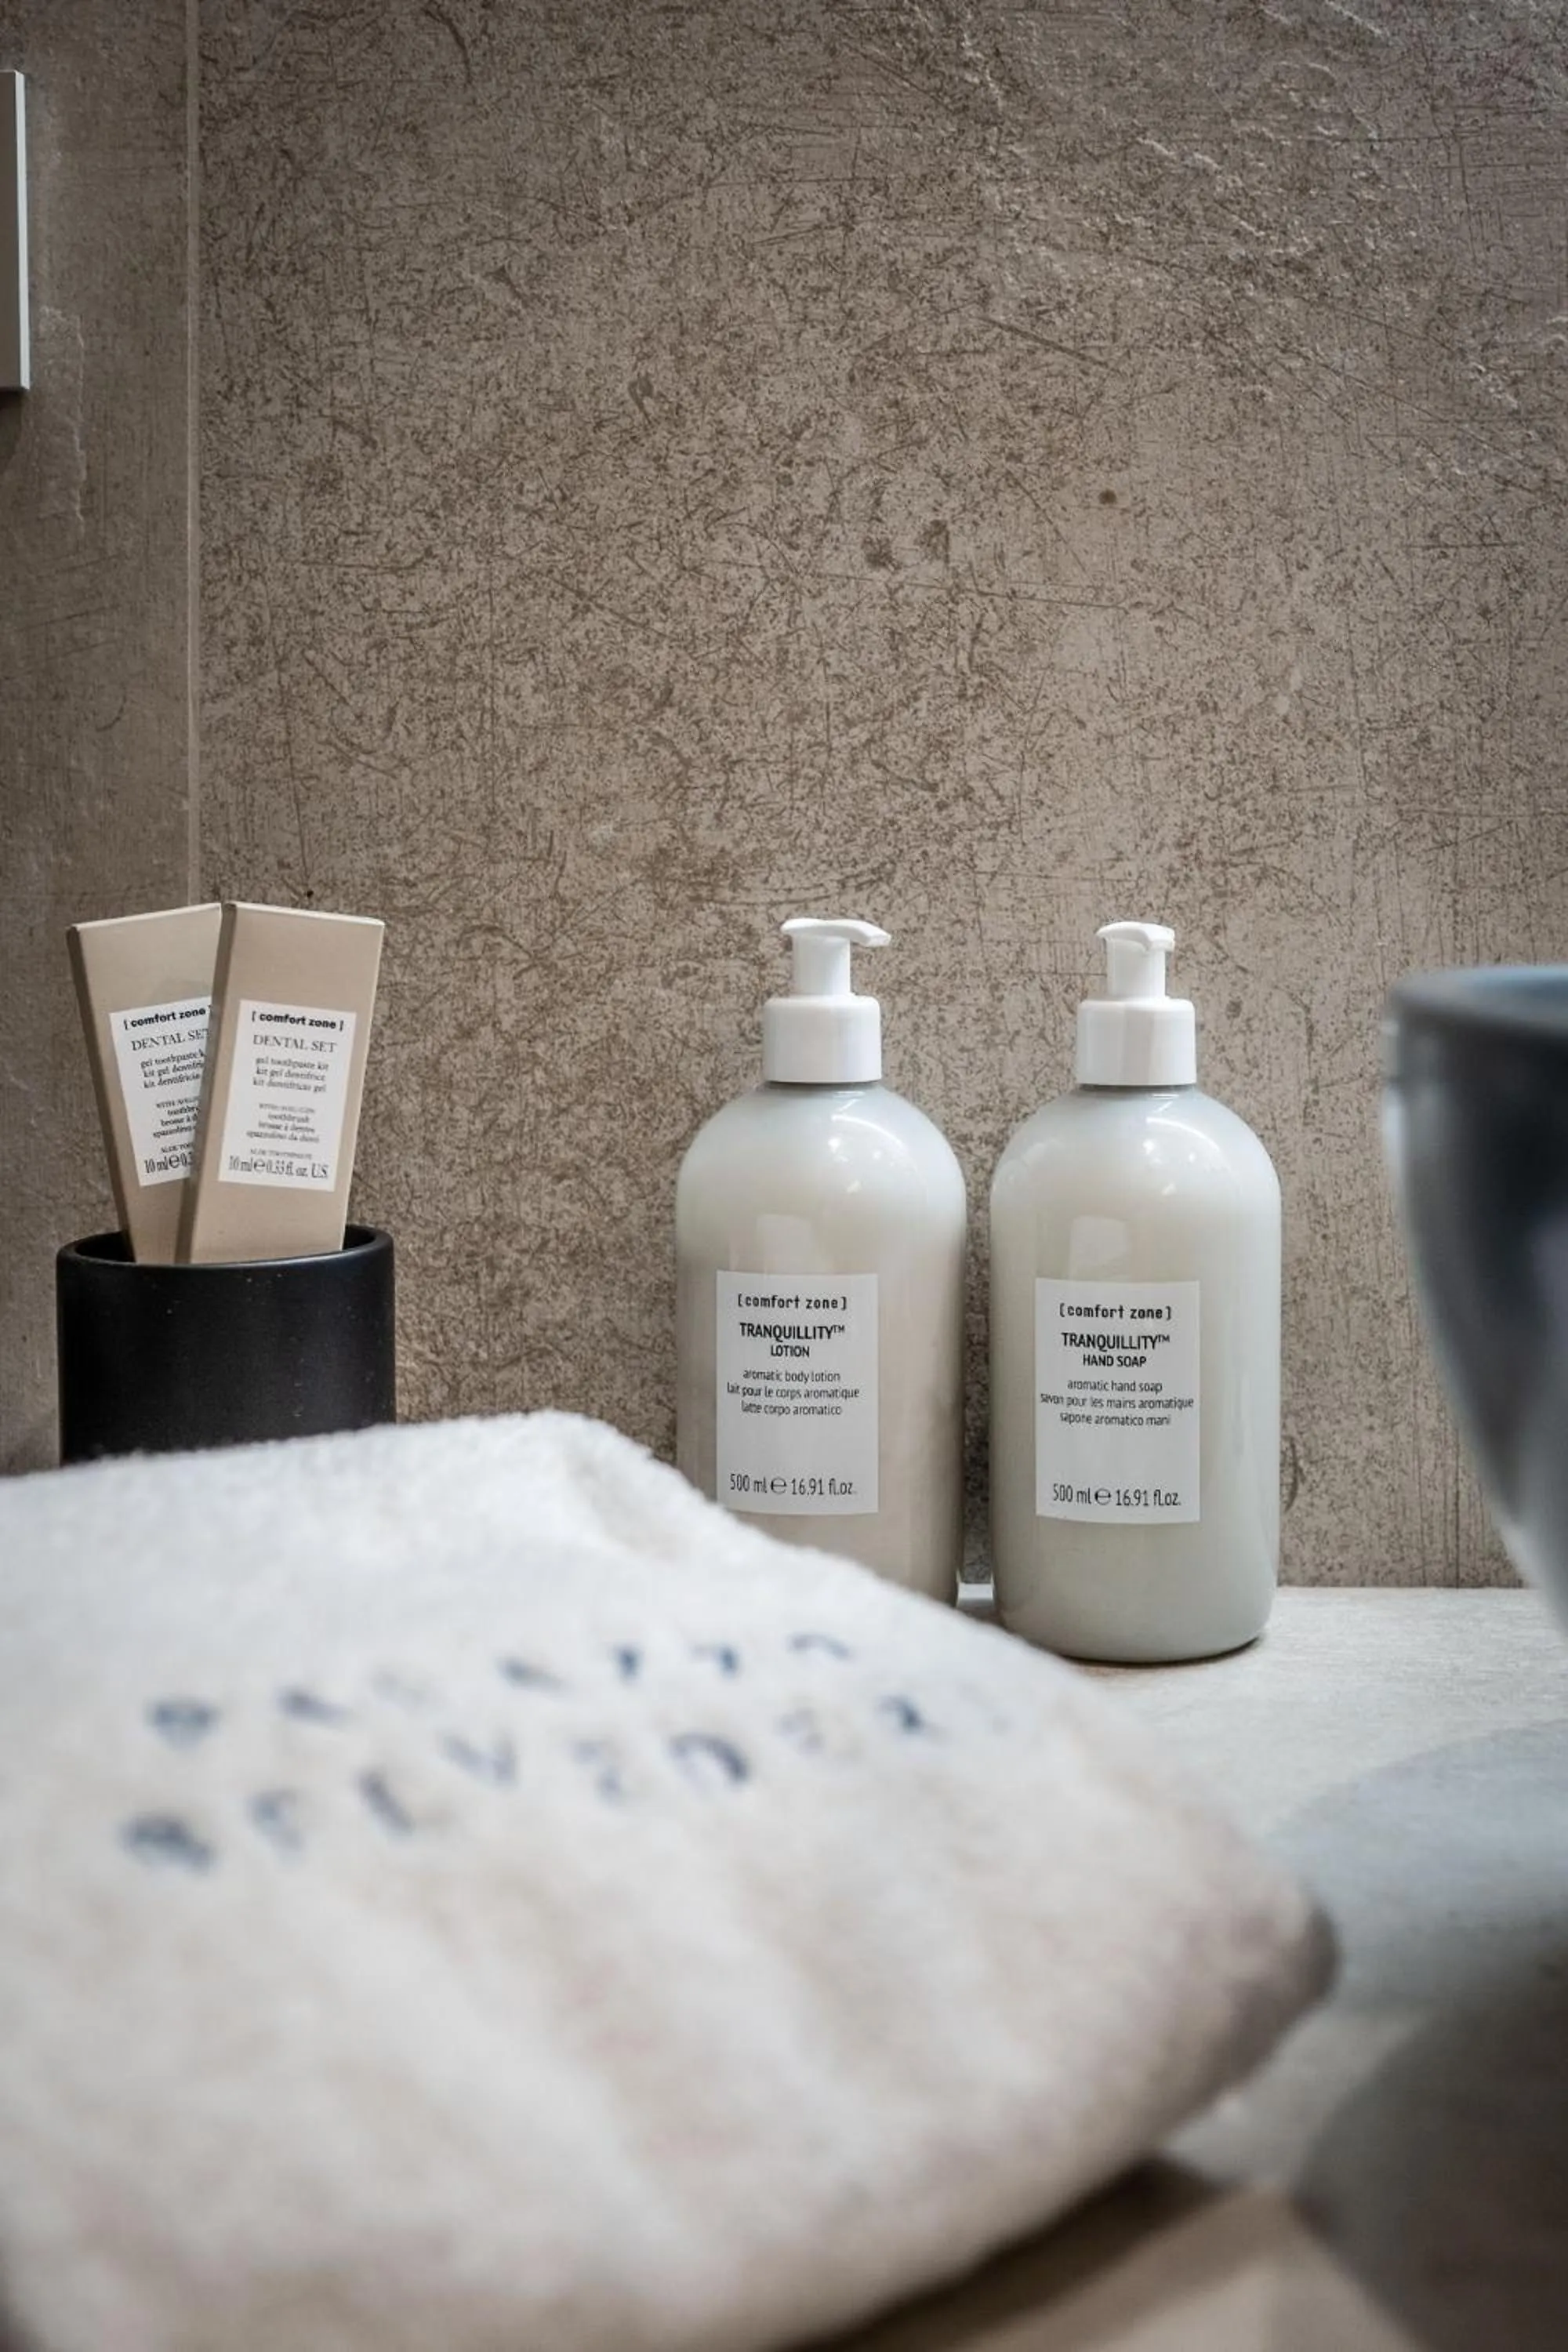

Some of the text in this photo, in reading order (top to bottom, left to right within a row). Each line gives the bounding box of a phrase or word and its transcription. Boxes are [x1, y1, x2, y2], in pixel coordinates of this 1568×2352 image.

[131, 1011, 177, 1028] comfort
[179, 1007, 206, 1020] zone
[260, 1013, 306, 1026] comfort
[308, 1018, 337, 1029] zone
[131, 1033, 186, 1051] DENTAL
[253, 1034, 338, 1053] DENTAL SET
[140, 1058, 153, 1069] gel
[158, 1065, 169, 1077] gel
[770, 1344, 811, 1358] LOTION
[1083, 1354, 1148, 1368] HAND SOAP
[742, 1368, 841, 1385] aromatic body lotion
[727, 1381, 860, 1401] lait pour le corps aromatique
[1067, 1379, 1163, 1396] aromatic hand soap
[741, 1400, 843, 1417] latte corpo aromatico
[1066, 1396, 1087, 1408] pour
[1091, 1396, 1105, 1409] les
[1106, 1397, 1136, 1410] mains
[1138, 1396, 1195, 1411] aromatique
[1094, 1414, 1144, 1426] aromatico
[1145, 1415, 1171, 1425] mani
[730, 1473, 750, 1492] 500
[753, 1475, 768, 1494] ml
[1053, 1483, 1074, 1503] 500
[1076, 1486, 1092, 1504] ml
